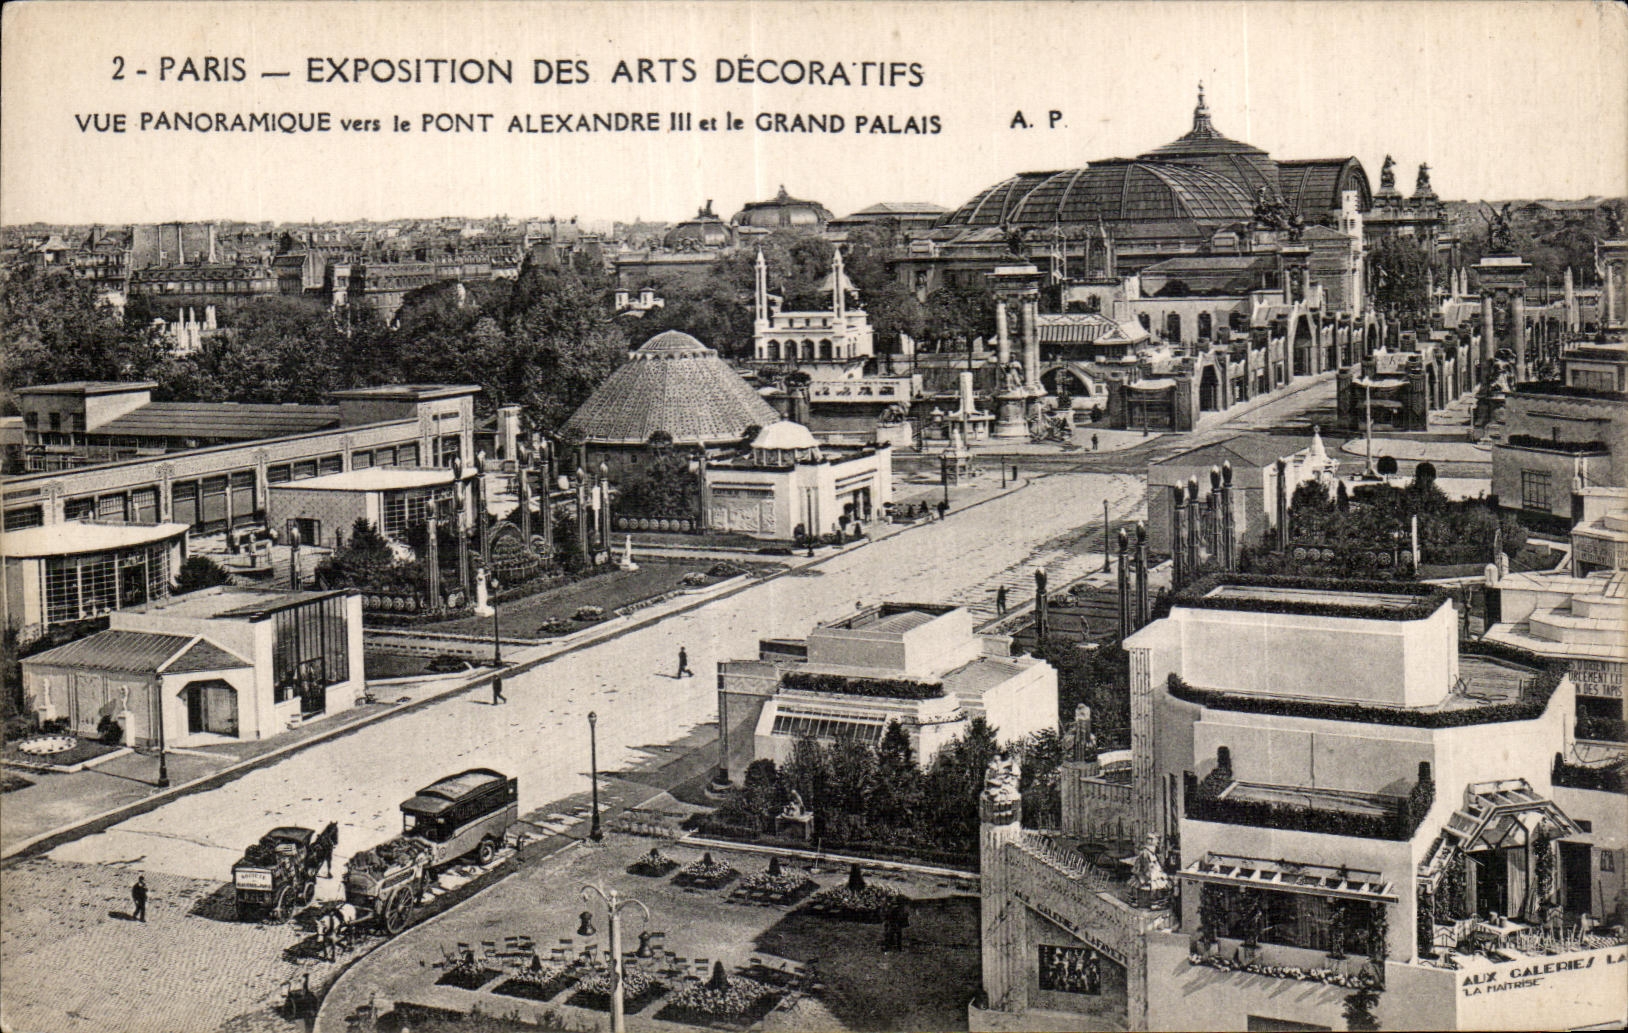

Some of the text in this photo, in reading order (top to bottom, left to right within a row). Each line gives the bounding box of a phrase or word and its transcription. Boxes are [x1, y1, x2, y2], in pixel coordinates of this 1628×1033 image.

[1583, 683, 1598, 696] DES
[1602, 684, 1623, 697] TAPIS
[1462, 972, 1497, 987] AUX
[1509, 956, 1596, 978] GALERIES
